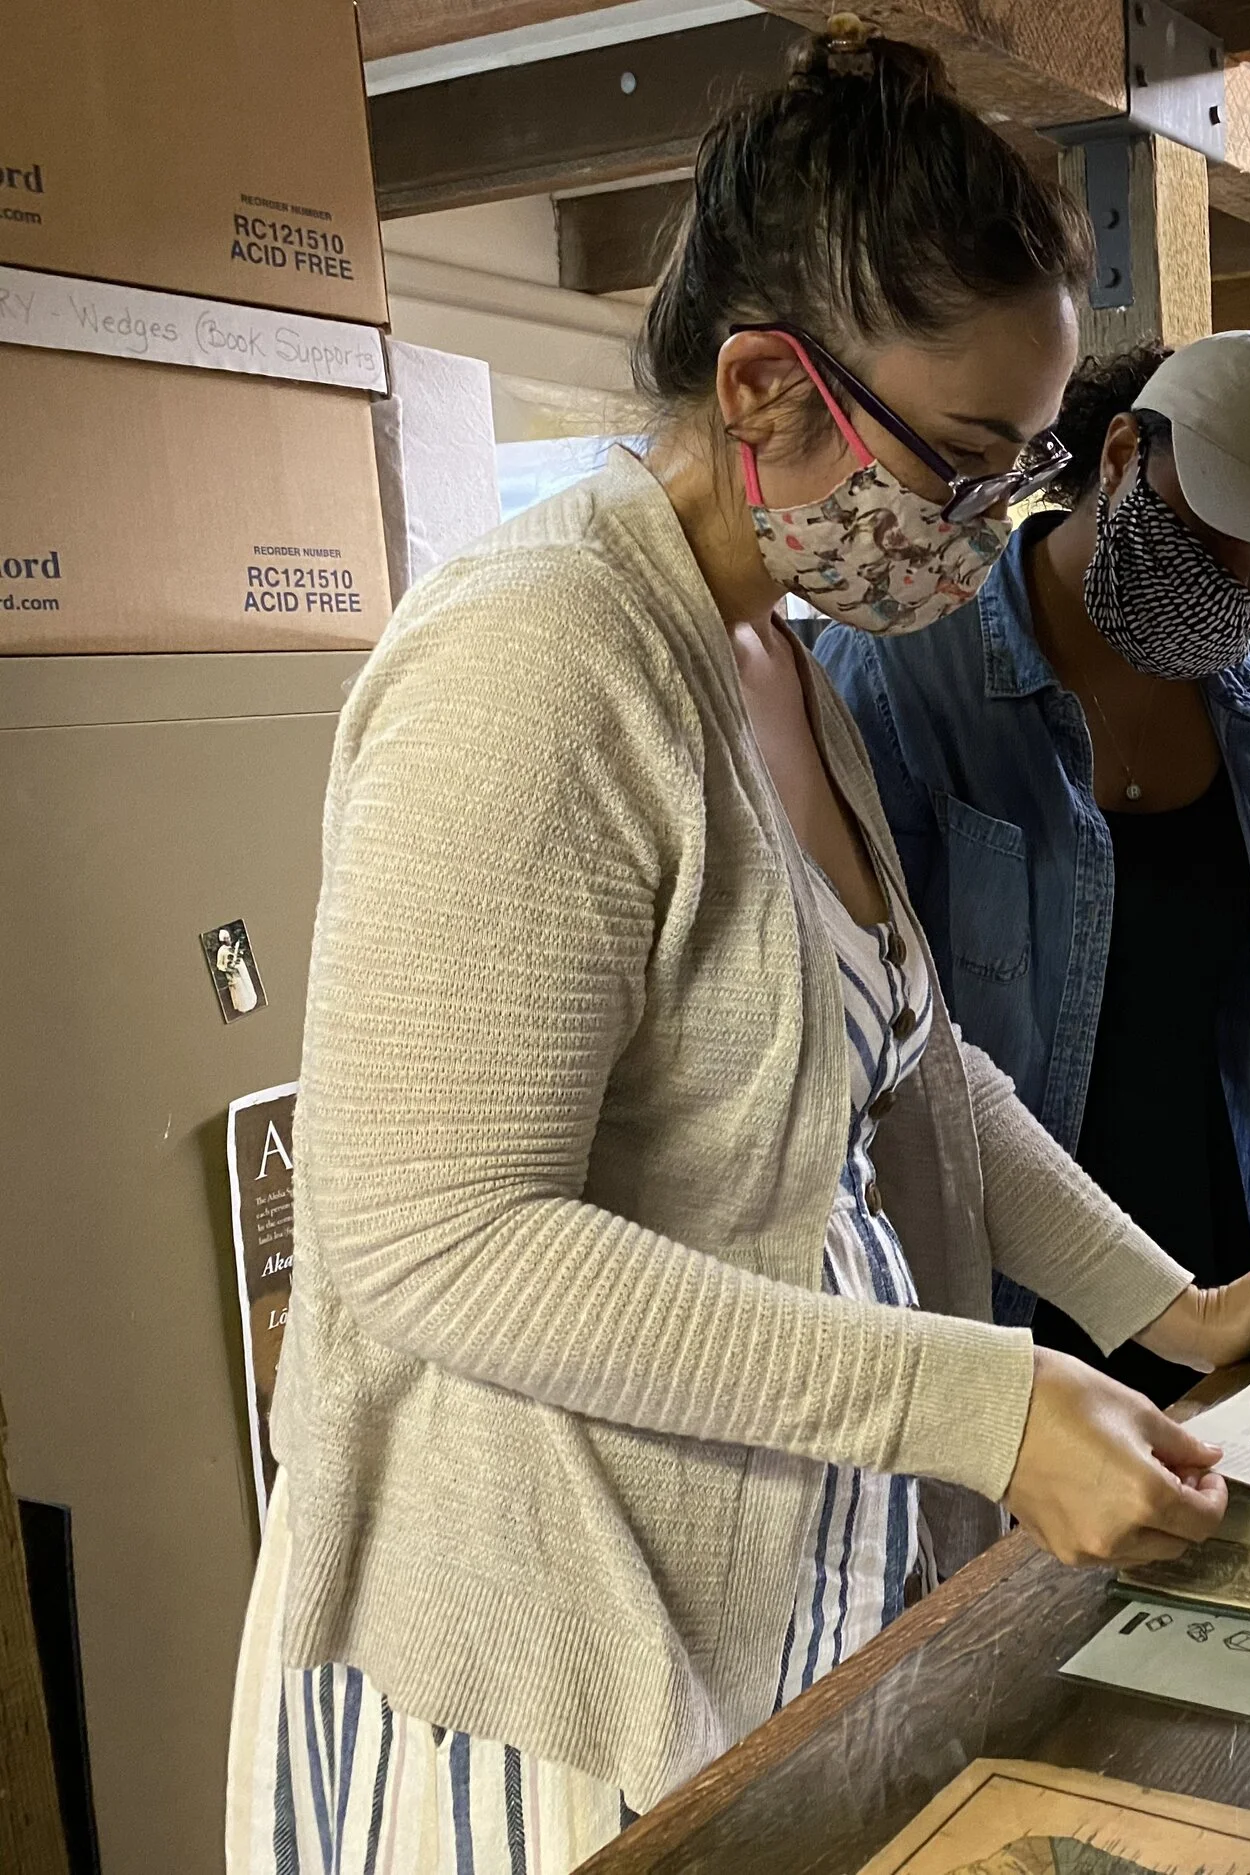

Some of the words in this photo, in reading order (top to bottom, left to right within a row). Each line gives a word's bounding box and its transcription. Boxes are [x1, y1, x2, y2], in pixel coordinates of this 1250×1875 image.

[0, 164, 44, 193] rd
[241, 193, 289, 212] REORDER
[291, 205, 332, 221] NUMBER
[234, 213, 344, 255] RC121510
[231, 239, 288, 268] ACID
[295, 250, 354, 280] FREE
[69, 295, 178, 353] Wedges
[196, 310, 267, 358] (Book
[0, 550, 62, 579] ord
[253, 546, 301, 556] REORDER
[303, 548, 342, 558] NUMBER
[247, 566, 353, 590] RC121510
[244, 591, 299, 612] ACID
[306, 592, 362, 613] FREE
